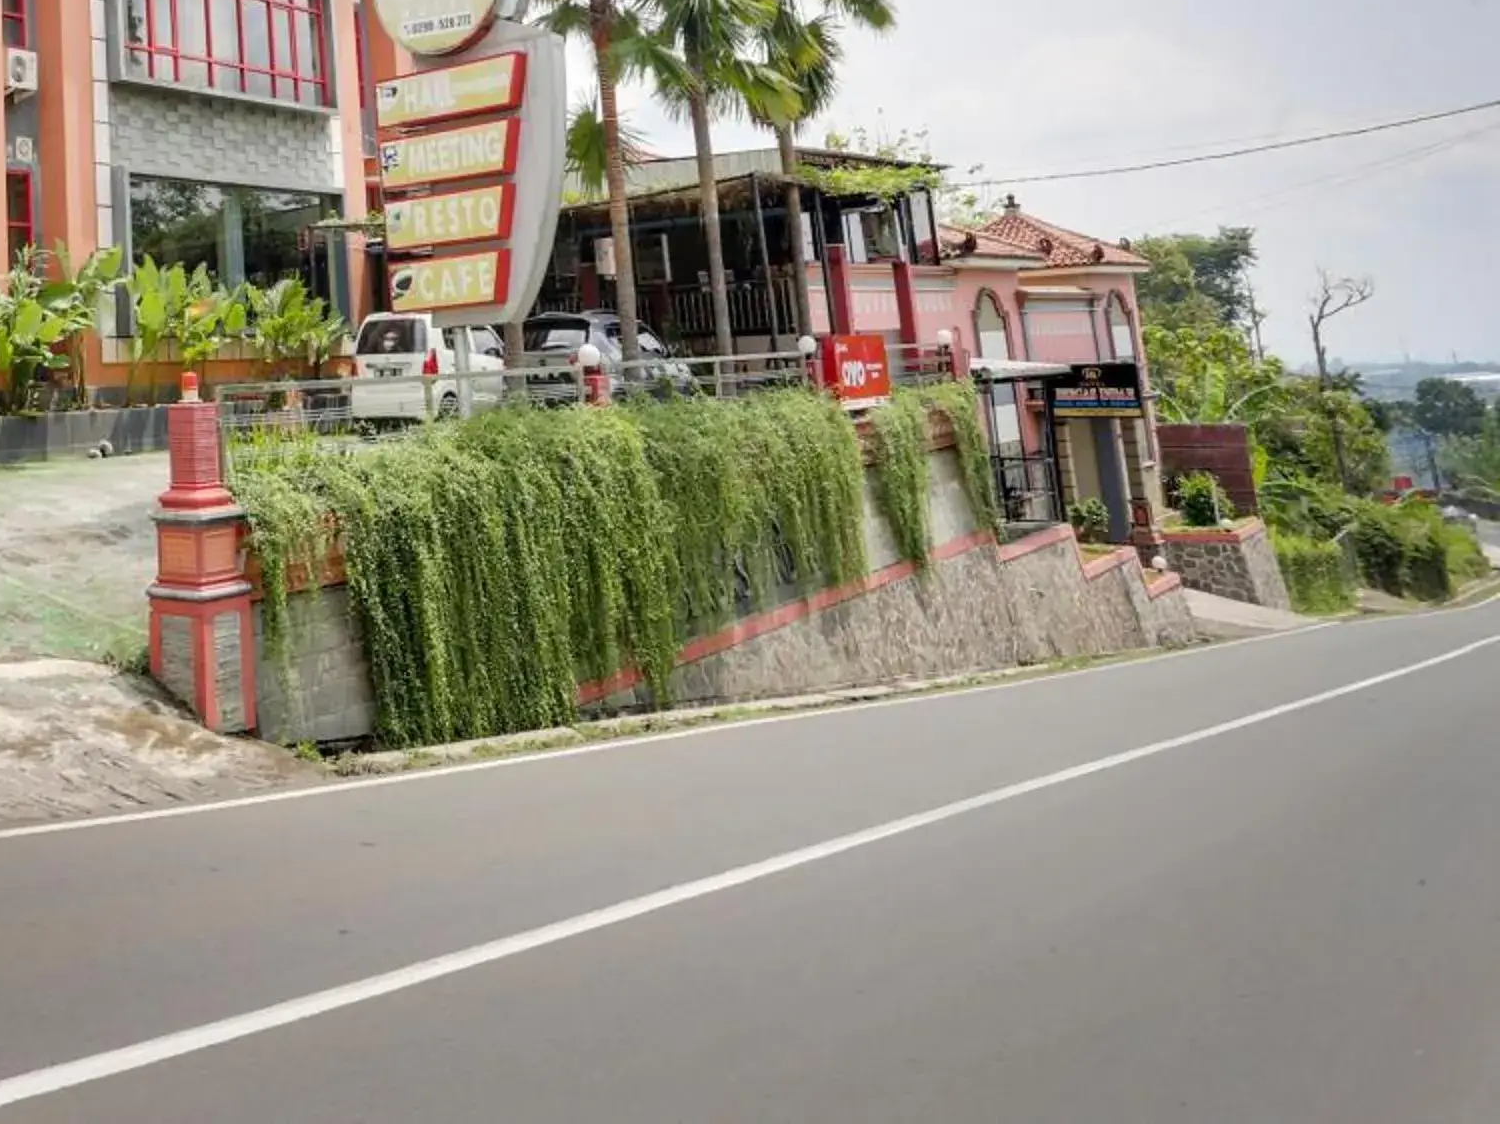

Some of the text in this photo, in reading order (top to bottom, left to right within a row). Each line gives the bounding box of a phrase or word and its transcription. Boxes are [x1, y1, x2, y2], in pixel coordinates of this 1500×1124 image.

[408, 128, 500, 176] MEETING
[414, 195, 498, 238] RESTO
[419, 259, 493, 302] CAFE
